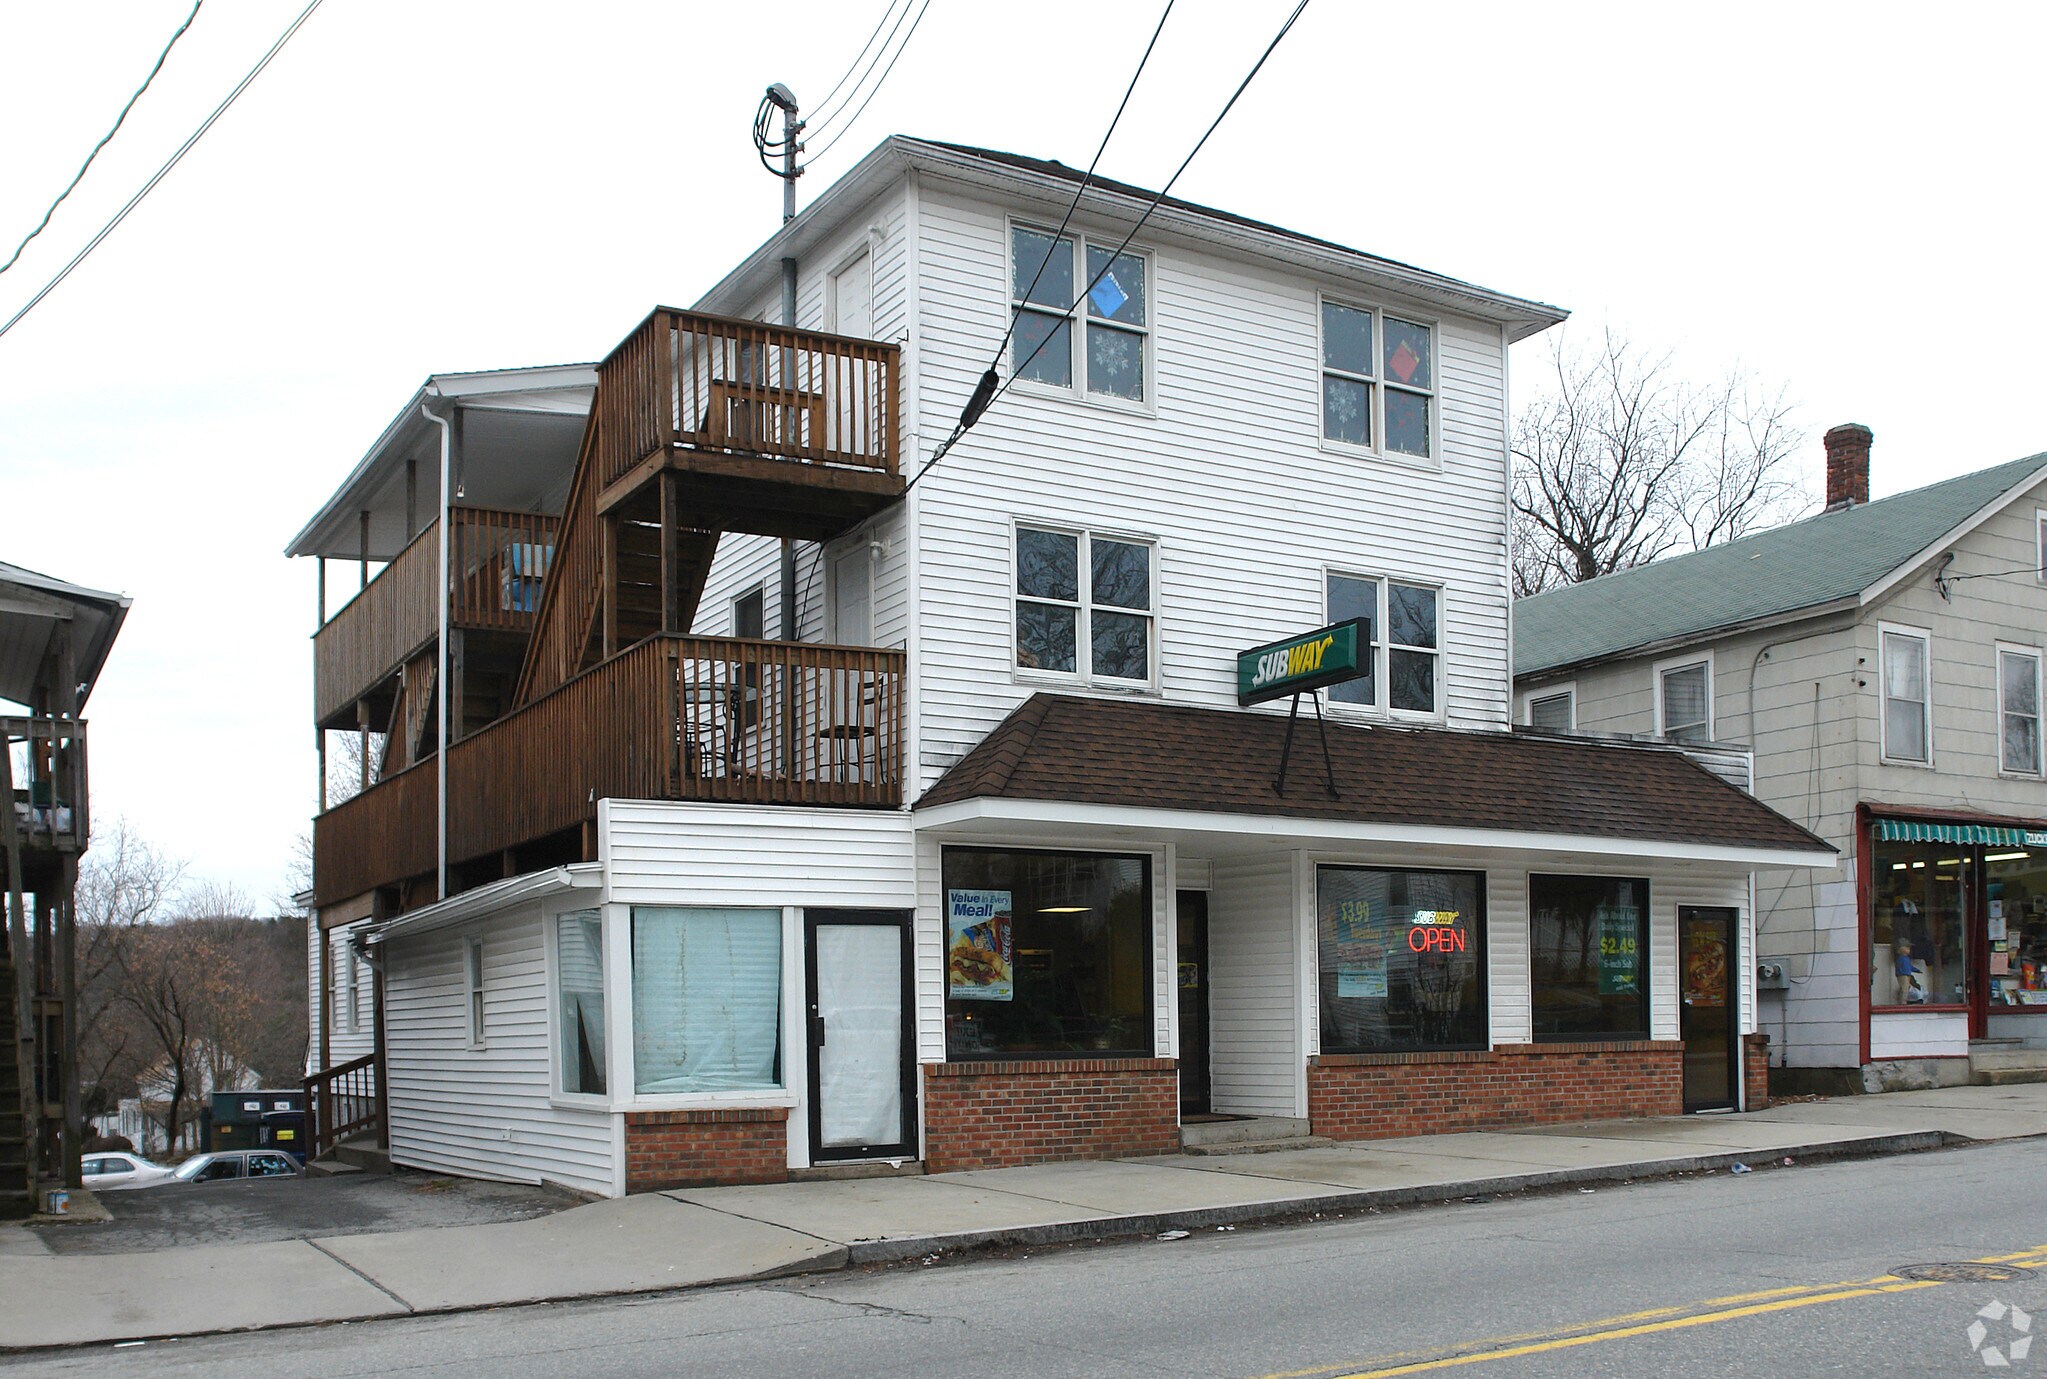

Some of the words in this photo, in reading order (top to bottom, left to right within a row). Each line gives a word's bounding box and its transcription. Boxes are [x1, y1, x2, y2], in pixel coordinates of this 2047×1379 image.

[1252, 634, 1334, 687] SUBWAY
[951, 893, 980, 903] Value
[990, 895, 1009, 905] Every
[953, 903, 993, 917] Meal!
[1341, 901, 1369, 923] $3.99
[1412, 910, 1460, 925] SUBWAY
[1408, 926, 1465, 952] OPEN
[1600, 936, 1636, 955] $2.49
[1622, 959, 1633, 968] Sub
